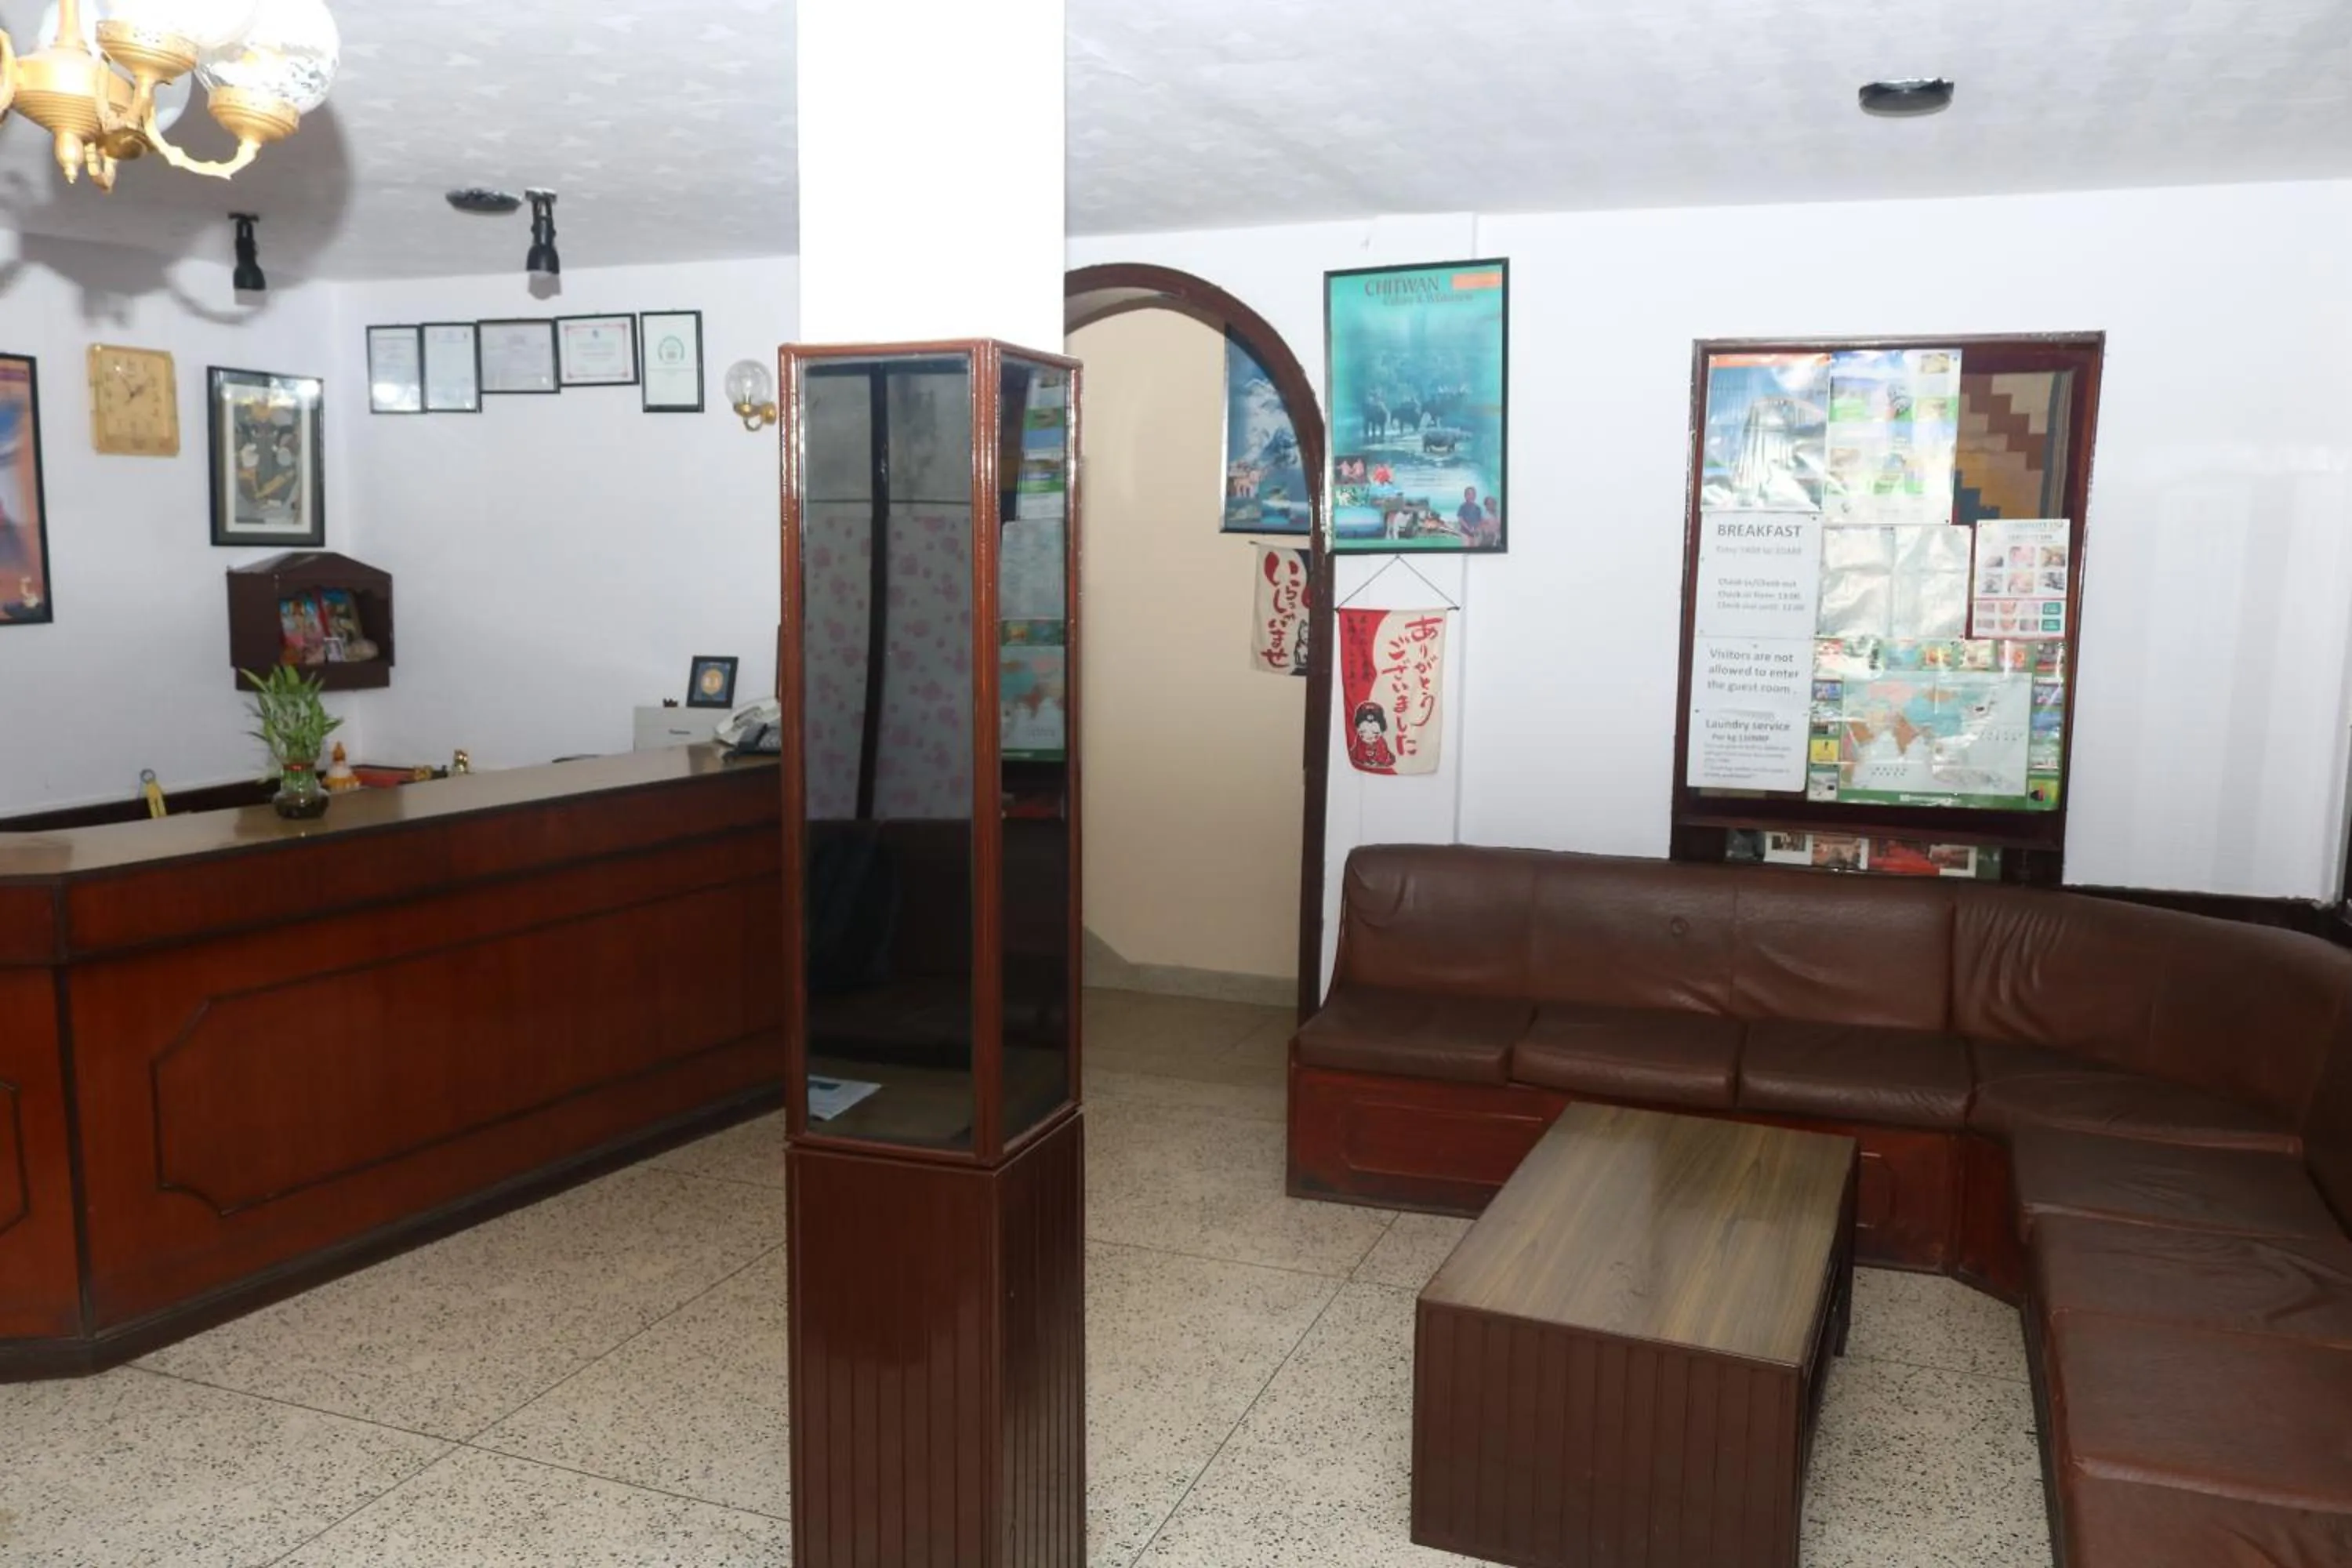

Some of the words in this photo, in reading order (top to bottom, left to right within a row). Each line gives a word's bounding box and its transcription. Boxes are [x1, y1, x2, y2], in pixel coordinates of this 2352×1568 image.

[1364, 276, 1439, 296] CHITWAN
[1718, 523, 1802, 538] BREAKFAST
[1709, 648, 1751, 660] Visitors
[1753, 652, 1772, 662] are
[1774, 652, 1794, 662] not
[1405, 615, 1443, 727] ありがとう
[1708, 664, 1752, 677] allowed
[1755, 667, 1766, 677] to
[1769, 669, 1800, 679] enter
[1708, 679, 1724, 690] the
[1727, 681, 1758, 693] guest
[1760, 684, 1791, 695] room
[1381, 637, 1417, 756] ございました
[1705, 719, 1750, 731] Laundry
[1752, 720, 1791, 731] service
